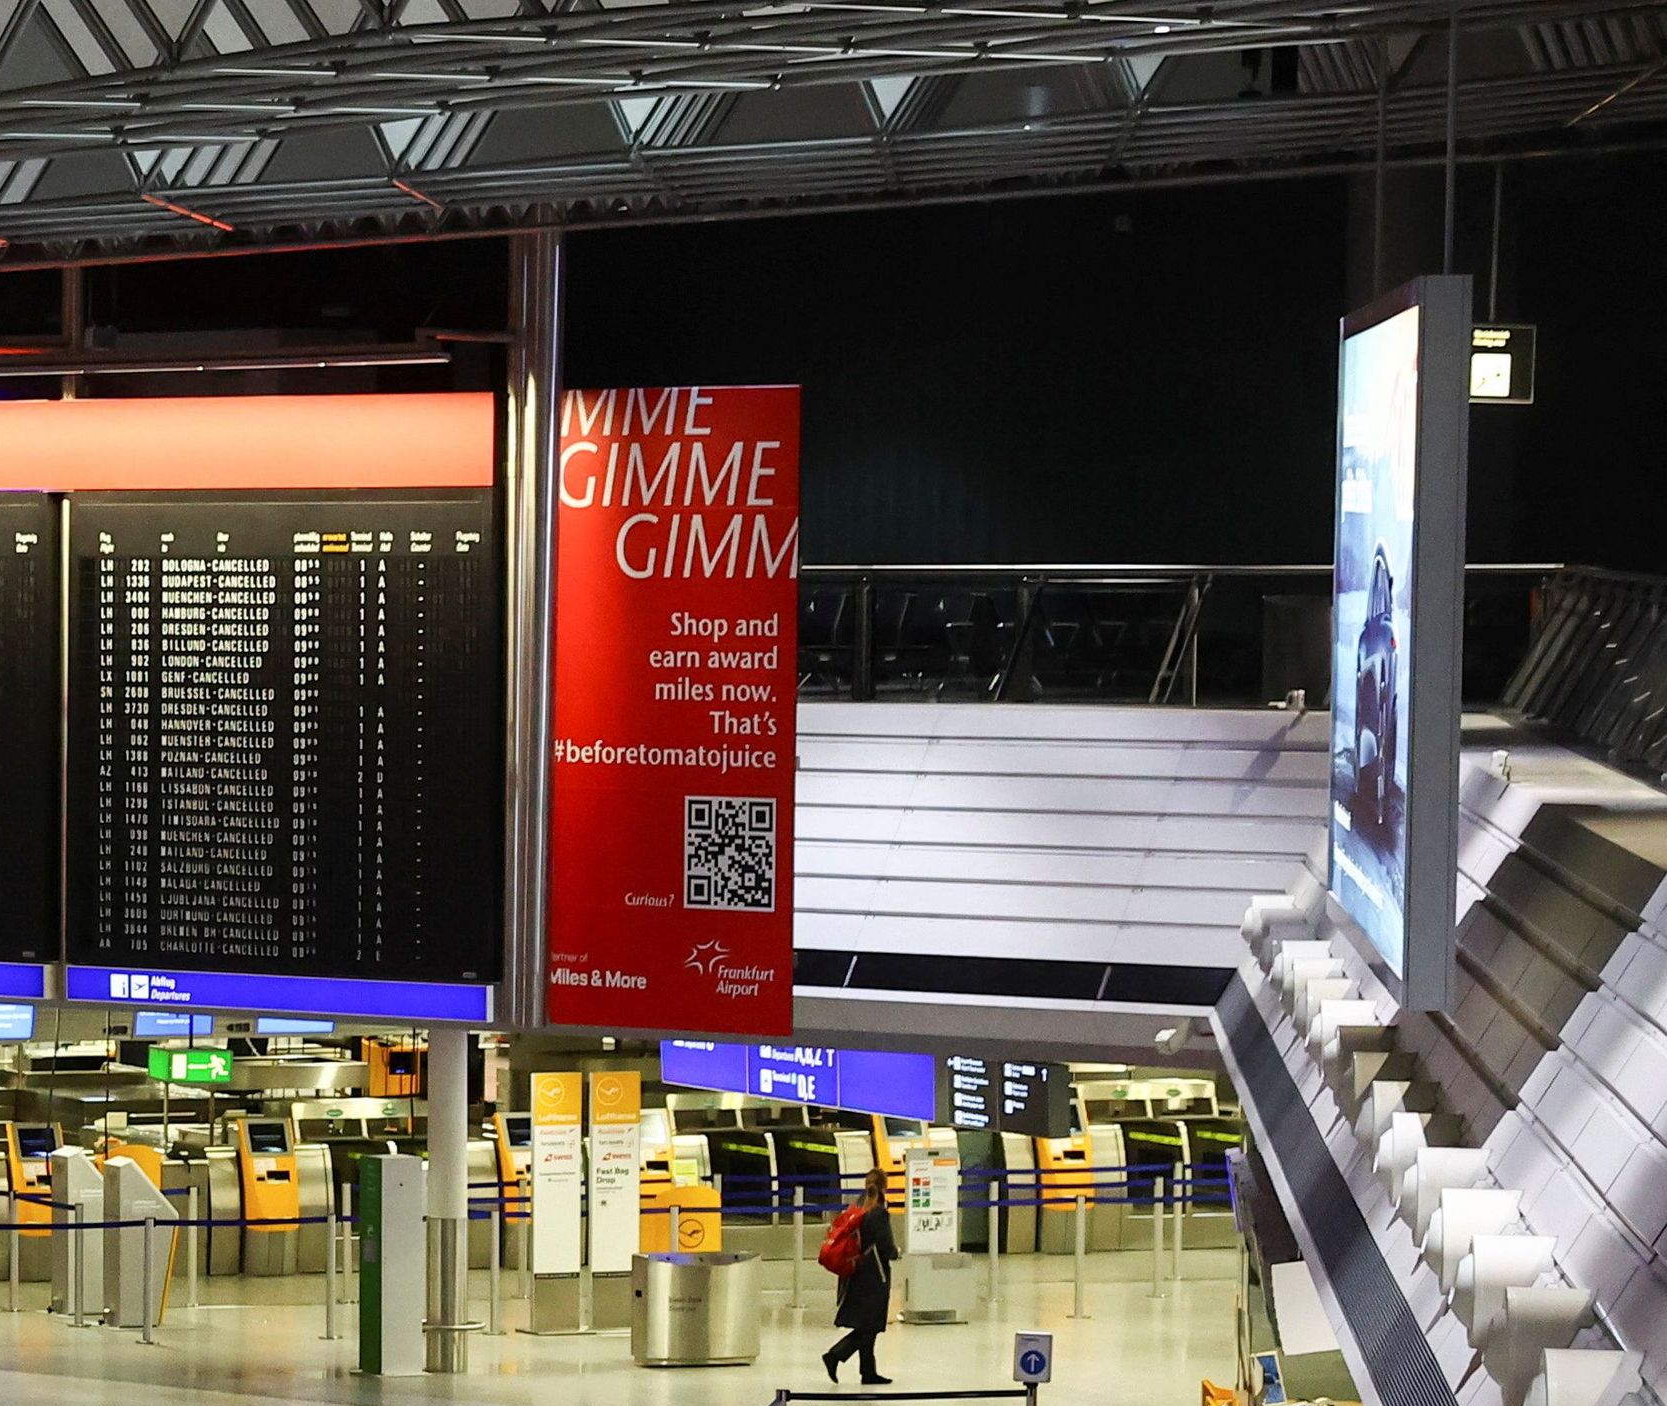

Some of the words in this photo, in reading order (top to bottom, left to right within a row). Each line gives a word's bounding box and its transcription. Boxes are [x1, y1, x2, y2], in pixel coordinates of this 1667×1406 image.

[560, 441, 780, 508] GIMME
[616, 513, 798, 580] GIMM
[163, 560, 269, 572] BOLOGNA-CANCELLED
[162, 575, 275, 588] BUDAPEST-CANCELLED
[162, 623, 268, 636] DRESDEN-CANCELLED
[670, 612, 727, 642] Shop
[735, 613, 778, 637] and
[162, 656, 262, 668] LONDON-CANCELLED
[649, 652, 699, 669] earn
[707, 647, 778, 670] award
[100, 669, 114, 681] LX
[162, 671, 249, 684] GENF-CANCELLED
[162, 687, 274, 700] BRUESSEL-CANCELLED
[655, 678, 714, 702] miles
[722, 683, 777, 702] now.
[162, 703, 267, 716] DRESDEN-CANCELLED
[710, 710, 777, 735] That's
[555, 738, 776, 774] #beforetomatojuice
[625, 892, 675, 907] Curious?
[591, 969, 602, 987] &
[606, 971, 647, 990] More
[717, 964, 775, 982] Frankfurt
[151, 976, 175, 990] Abflug
[151, 988, 191, 1001] Departures
[716, 983, 758, 999] Airport
[596, 1167, 612, 1176] Fast
[596, 1176, 616, 1187] Drop
